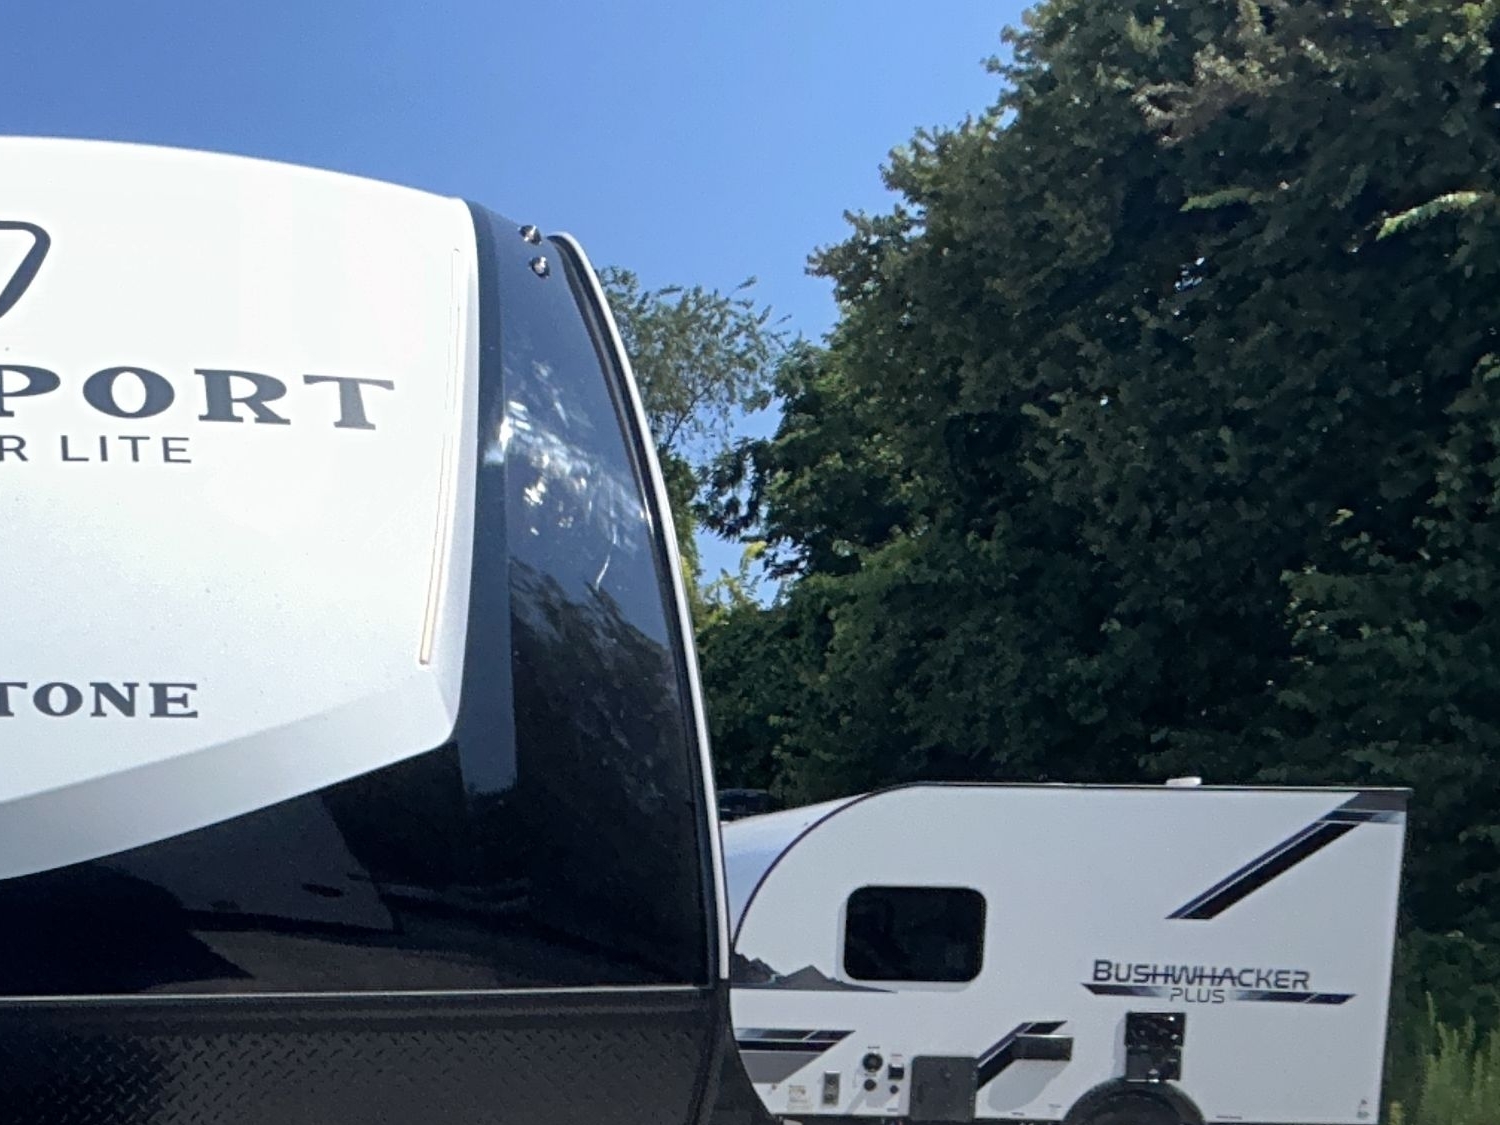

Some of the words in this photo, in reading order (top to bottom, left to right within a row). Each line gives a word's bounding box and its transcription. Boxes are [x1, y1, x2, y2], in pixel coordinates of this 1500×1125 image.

[61, 434, 192, 464] LITE
[1092, 959, 1311, 990] BUSHWHACKER
[1169, 987, 1226, 1004] PLUS
